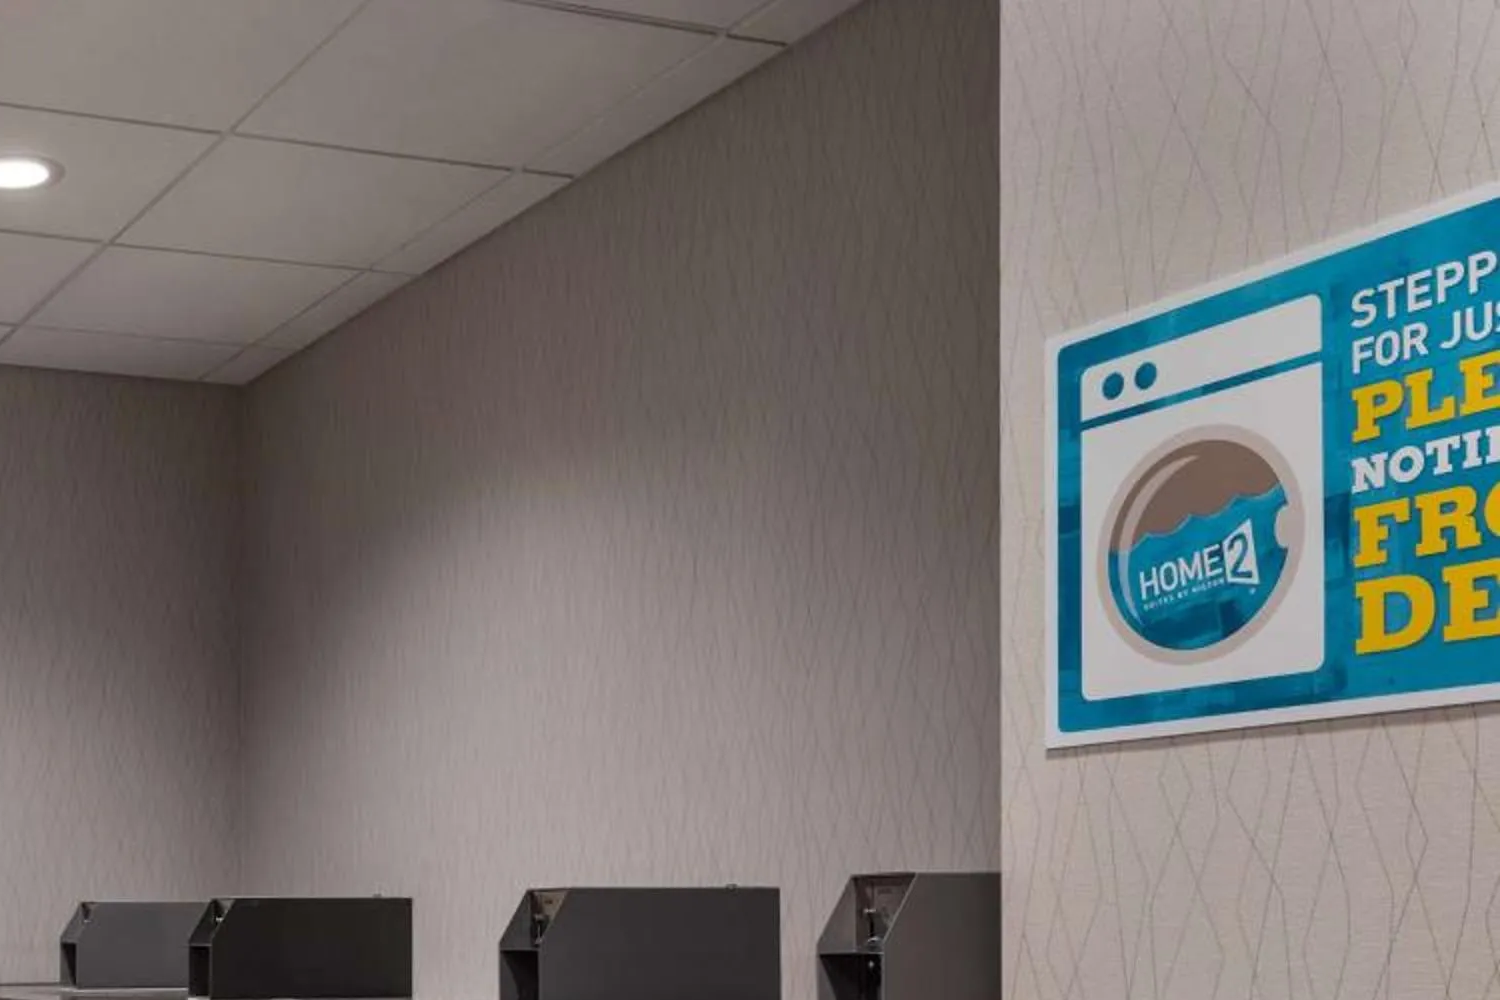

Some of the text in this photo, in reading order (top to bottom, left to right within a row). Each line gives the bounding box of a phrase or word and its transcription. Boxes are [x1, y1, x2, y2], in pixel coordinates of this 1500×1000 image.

[1350, 250, 1497, 329] STEPP
[1352, 300, 1500, 375] FOR JU
[1351, 349, 1500, 443] PLE
[1353, 481, 1500, 568] FR
[1355, 557, 1500, 655] DE
